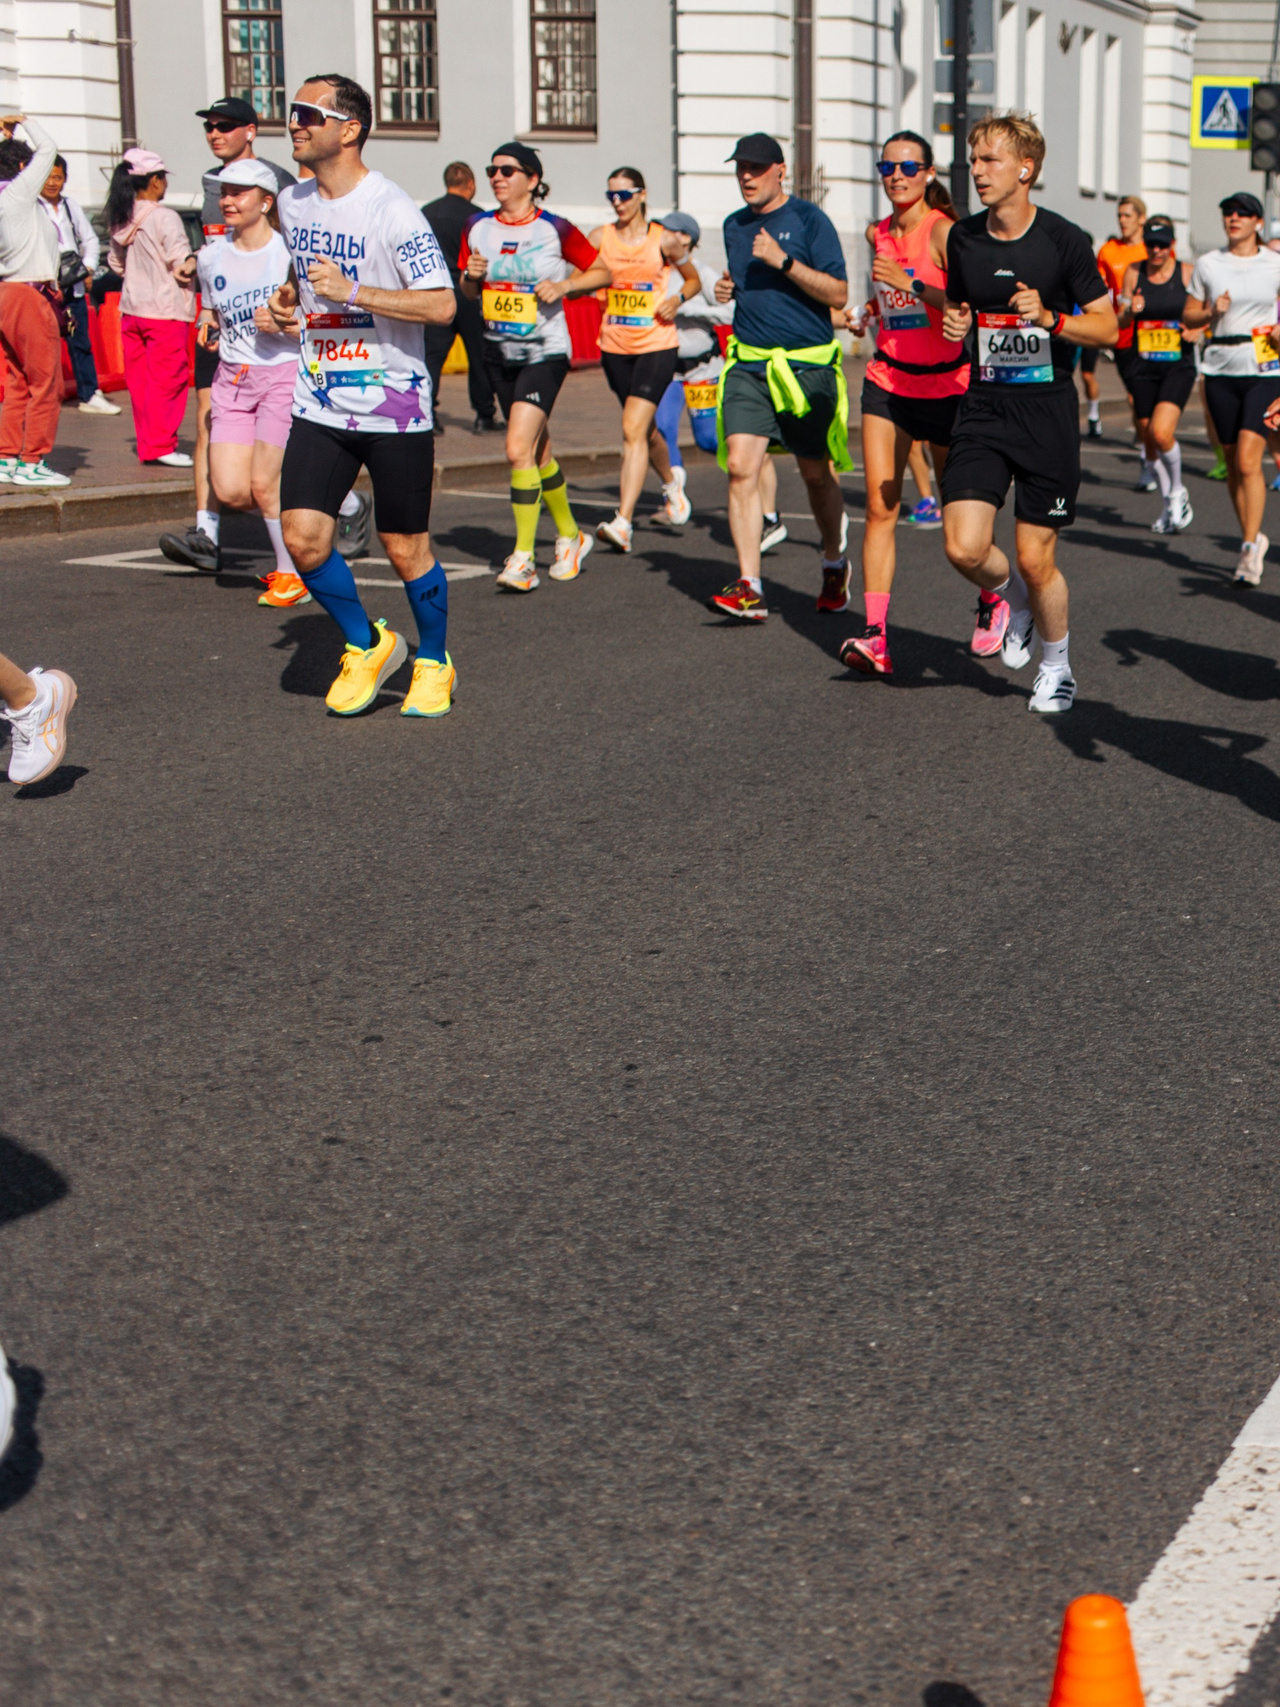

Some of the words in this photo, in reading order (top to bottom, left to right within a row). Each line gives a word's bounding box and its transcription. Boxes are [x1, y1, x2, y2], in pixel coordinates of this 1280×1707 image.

[289, 222, 366, 261] ЗВЁЗДЫ
[214, 283, 279, 314] ЫСТРЕЕ
[494, 295, 523, 313] 665
[613, 293, 647, 308] 1704
[879, 289, 917, 310] 7384
[313, 338, 370, 362] 7844
[987, 334, 1041, 355] 6400
